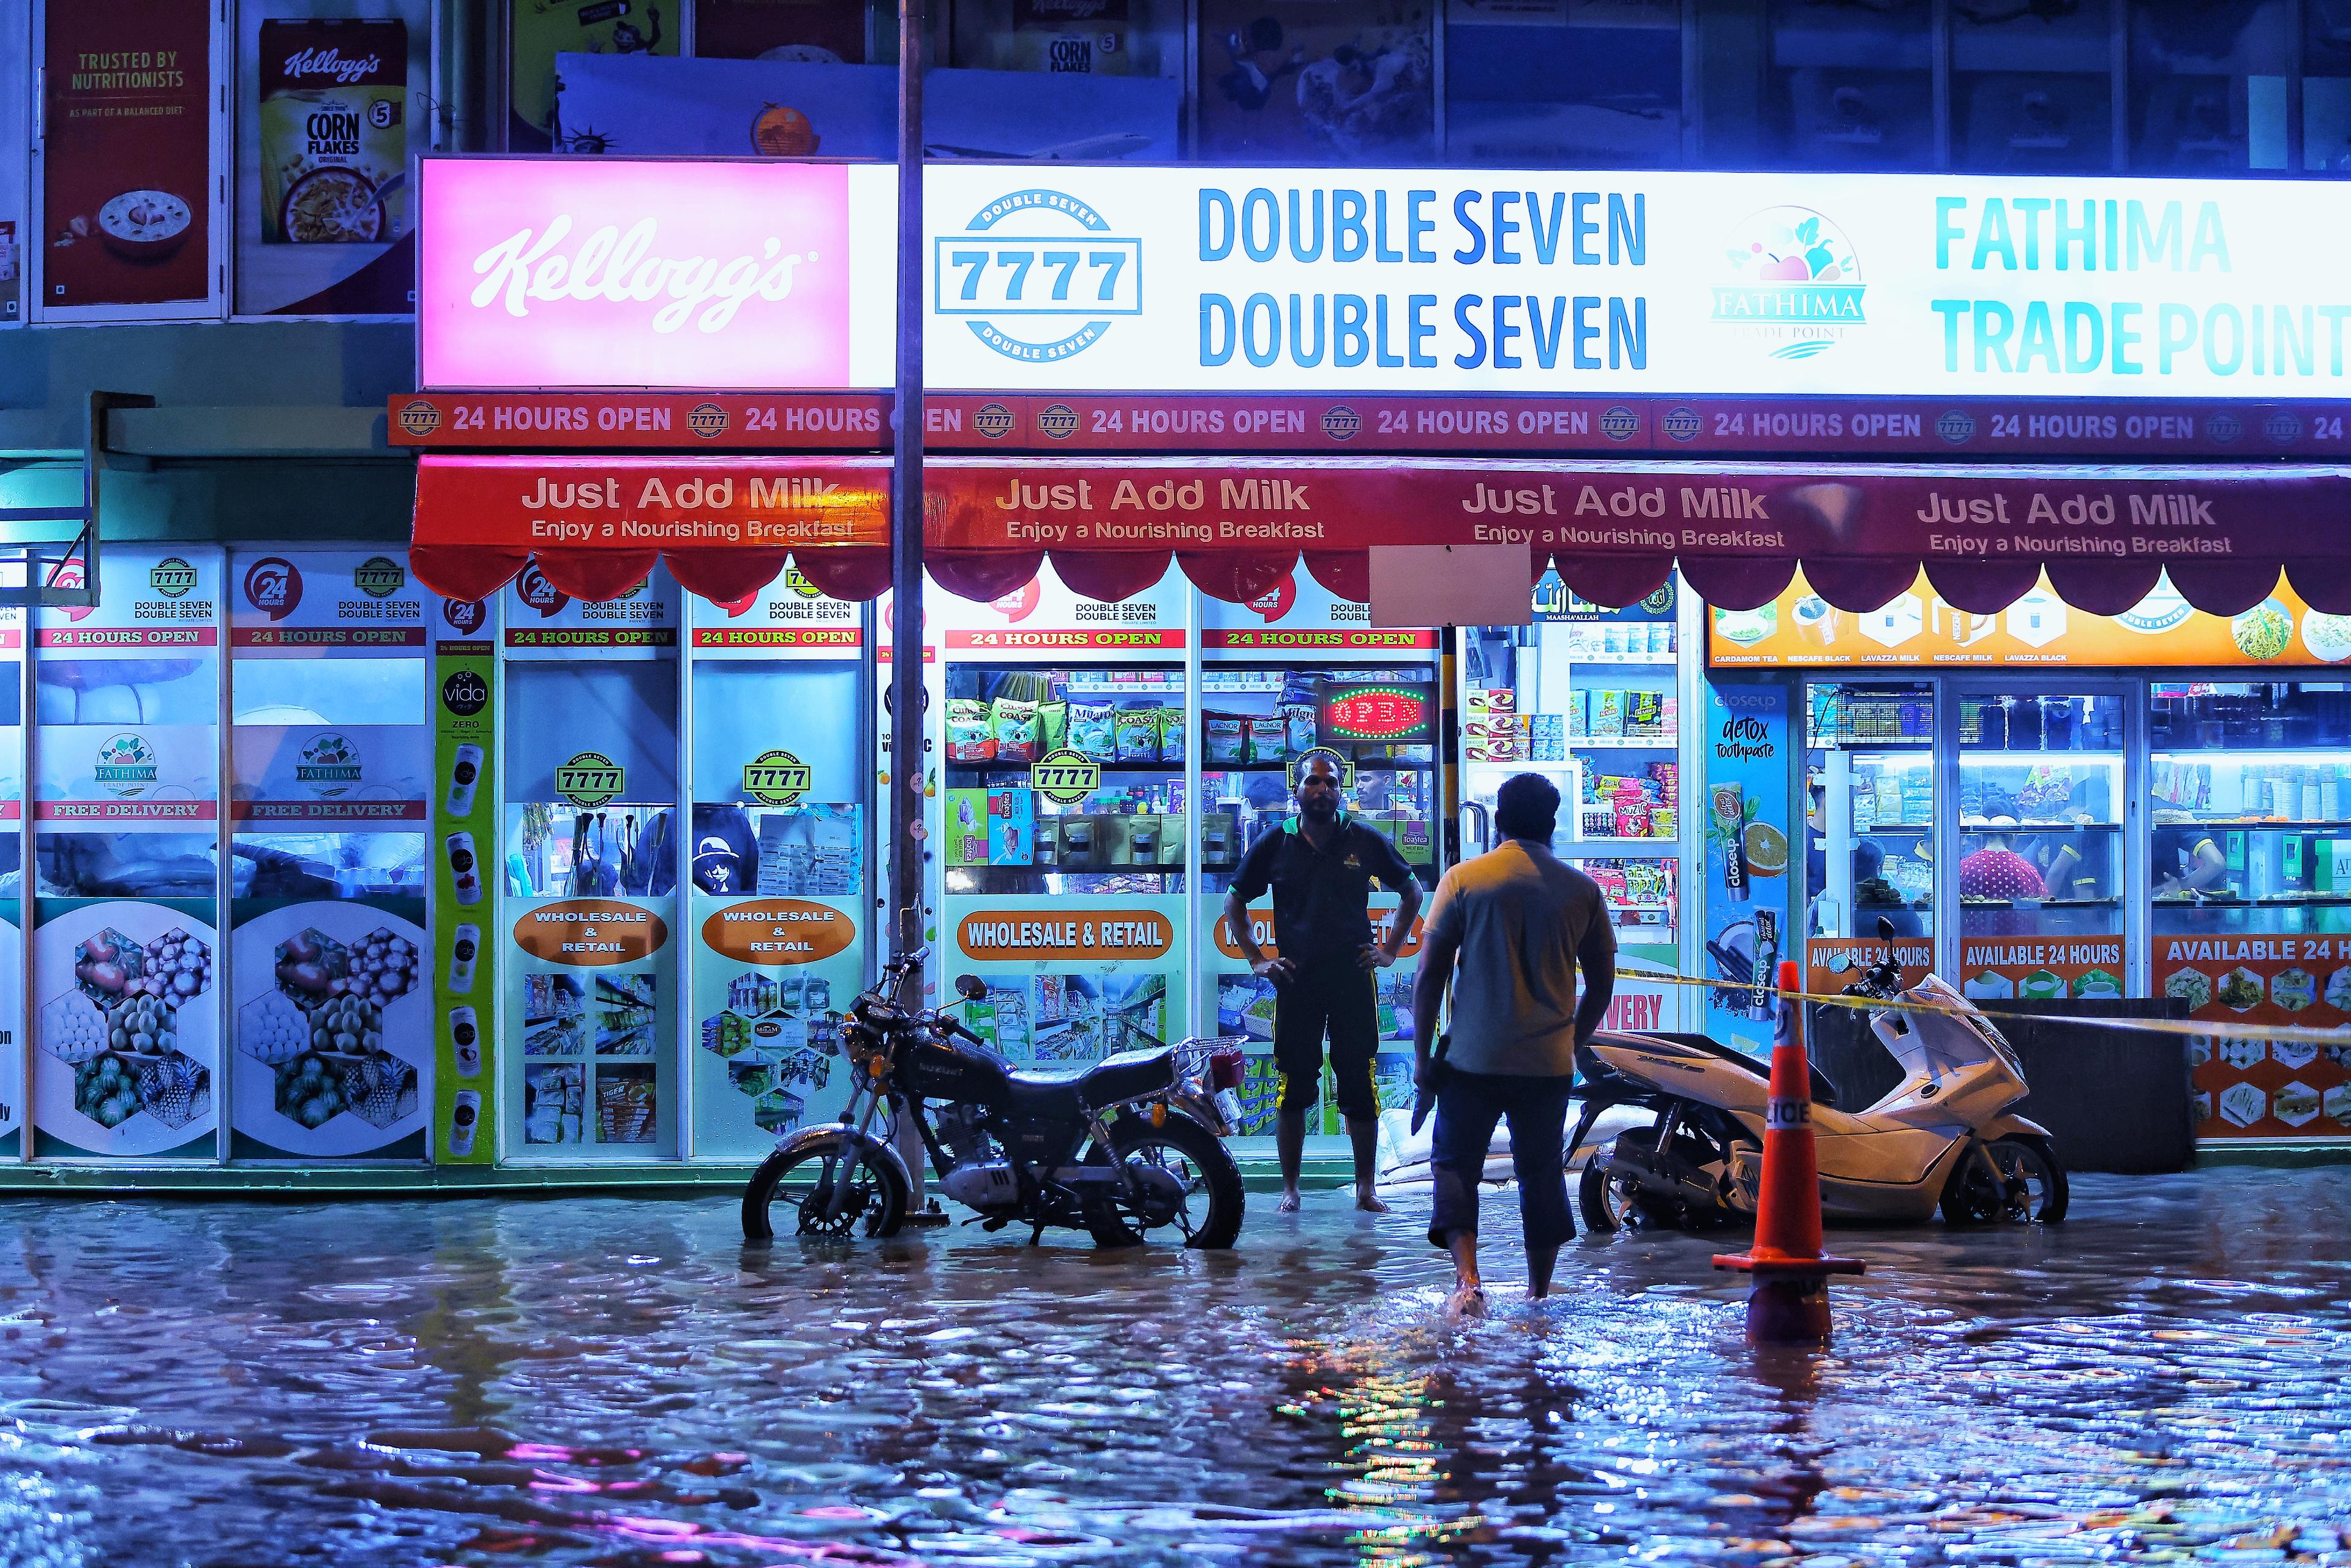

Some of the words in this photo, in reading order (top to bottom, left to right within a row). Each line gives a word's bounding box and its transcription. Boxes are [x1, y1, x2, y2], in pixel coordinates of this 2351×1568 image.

[1049, 40, 1090, 61] CORN
[78, 51, 151, 70] TRUSTED
[156, 51, 178, 68] BY
[283, 47, 381, 83] Kellogg's
[1050, 62, 1091, 73] FLAKES
[72, 70, 184, 90] NUTRITIONISTS
[69, 109, 80, 118] AS
[81, 108, 103, 117] PART
[104, 108, 115, 116] OF
[117, 108, 122, 116] A
[124, 107, 164, 116] BALANCED
[376, 107, 388, 123] 5
[306, 113, 360, 141] CORN
[307, 141, 360, 154] FLAKES
[1199, 188, 1437, 263] DOUBLE
[1453, 190, 1646, 266] SEVEN
[1935, 197, 2232, 272] FATHIMA
[471, 214, 802, 334] Kellogg's
[952, 251, 1126, 300] 7777
[1718, 291, 1862, 318] FATHIMA
[1199, 293, 1438, 367] DOUBLE
[1453, 294, 1646, 369] SEVEN
[1733, 326, 1783, 339] TRADE
[1791, 326, 1846, 339] POINT
[1931, 299, 2143, 375] TRADE
[2158, 302, 2351, 377] POINT
[453, 407, 486, 430] 24
[494, 407, 588, 430] HOURS
[598, 407, 671, 430] OPEN
[977, 416, 1011, 426] 7777
[1378, 411, 1408, 433] 24
[1417, 411, 1509, 434] HOURS
[1518, 411, 1588, 435] OPEN
[1603, 418, 1637, 429] 7777
[1715, 413, 1744, 435] 24
[1753, 413, 1843, 437] HOURS
[1851, 415, 1921, 437] OPEN
[2314, 417, 2344, 440] 24
[522, 477, 621, 509] Just
[637, 478, 733, 509] Add
[749, 478, 841, 509] Milk
[995, 479, 1093, 511] Just
[1109, 479, 1205, 511] Add
[1219, 479, 1311, 511] Milk
[1462, 482, 1558, 516] Just
[1574, 485, 1667, 518] Add
[1680, 487, 1771, 520] Milk
[1917, 492, 2011, 524] Just
[2027, 493, 2116, 525] Add
[2128, 494, 2218, 526] Milk
[531, 520, 594, 541] Enjoy
[601, 522, 615, 537] a
[621, 520, 740, 541] Nourishing
[747, 520, 854, 537] Breakfast
[1473, 524, 1534, 544] Enjoy
[1542, 527, 1555, 542] a
[1560, 527, 1676, 549] Nourishing
[1681, 530, 1785, 547] Breakfast
[1929, 535, 1990, 555] Enjoy
[1997, 537, 2009, 551] a
[2014, 535, 2129, 557] Nourishing
[2131, 536, 2233, 553] Breakfast
[359, 571, 400, 583] 7777
[259, 576, 288, 599] 24
[530, 576, 557, 597] 24
[135, 601, 177, 610] DOUBLE
[179, 601, 212, 609] SEVEN
[454, 604, 475, 620] 24
[996, 601, 1023, 609] HOURS
[51, 632, 74, 643] 24
[78, 632, 143, 643] HOURS
[147, 631, 200, 643] OPEN
[250, 631, 274, 643] 24
[279, 631, 347, 643] HOURS
[352, 631, 407, 643] OPEN
[701, 632, 724, 643] 24
[729, 632, 797, 643] HOURS
[801, 631, 857, 643] OPEN
[970, 633, 999, 645] 24
[1004, 633, 1089, 645] HOURS
[1095, 633, 1162, 645] OPEN
[444, 683, 485, 701] vida
[1714, 693, 1776, 709] closeup
[1333, 701, 1421, 723] OPEN
[1722, 715, 1770, 743] detox
[759, 751, 780, 762] DOUBLE
[781, 752, 797, 763] SEVEN
[1714, 741, 1775, 764] toothpaste
[99, 768, 156, 779] FATHIMA
[301, 768, 360, 779] FATHIMA
[1038, 769, 1093, 785] 7777
[571, 796, 591, 807] DOUBLE
[592, 796, 609, 806] SEVEN
[1047, 792, 1067, 803] DOUBLE
[1068, 793, 1084, 803] SEVEN
[53, 804, 102, 817] FREE
[105, 804, 200, 816] DELIVERY
[252, 805, 304, 817] FREE
[307, 805, 407, 817] DELIVERY
[1403, 835, 1428, 844] Toastea
[1727, 838, 1740, 887] closeup
[534, 912, 647, 923] WHOLESALE
[722, 911, 835, 923] WHOLESALE
[584, 926, 598, 938] &
[772, 926, 786, 937] &
[967, 922, 1077, 948] WHOLESALE
[1081, 922, 1096, 947] &
[1101, 922, 1163, 947] RETAIL
[562, 942, 626, 953] RETAIL
[749, 940, 814, 952] RETAIL
[1966, 945, 2045, 966] AVAILABLE
[2049, 945, 2066, 965] 24
[2069, 944, 2120, 966] HOURS
[2167, 940, 2297, 961] AVAILABLE
[2303, 939, 2331, 961] 24
[1753, 959, 1771, 1007] closeup
[602, 1086, 625, 1097] TIGER
